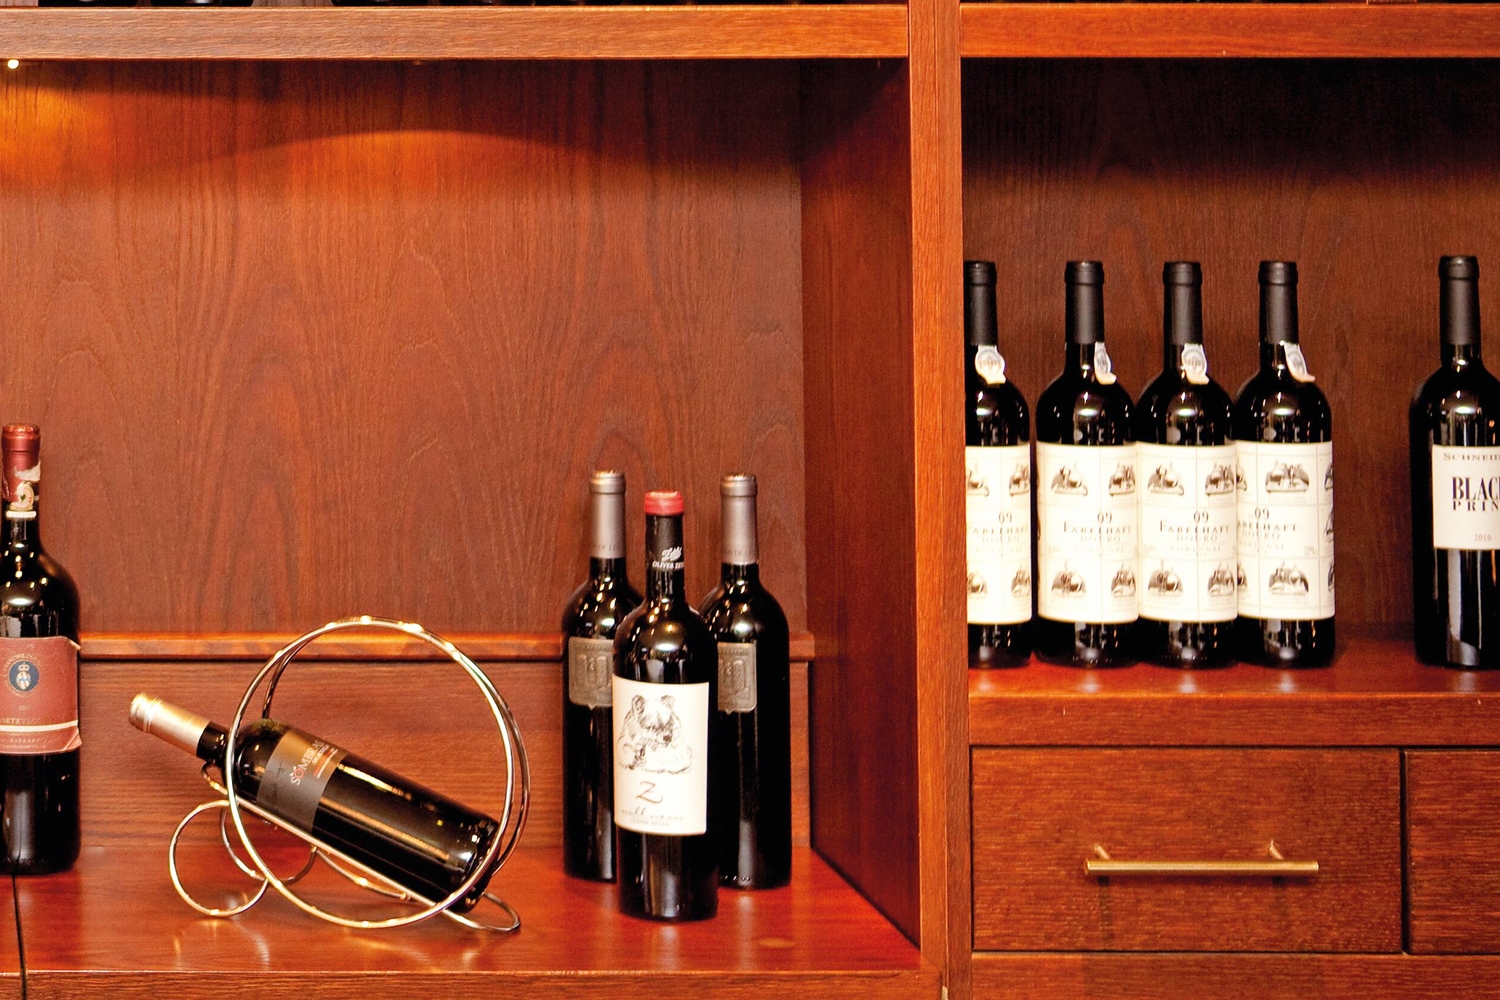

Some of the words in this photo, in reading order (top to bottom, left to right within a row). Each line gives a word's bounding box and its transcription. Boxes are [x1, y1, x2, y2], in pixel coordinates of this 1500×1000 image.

[1443, 452, 1500, 461] SCHNEID
[1452, 476, 1500, 500] BLAC
[1452, 500, 1500, 512] PRIN
[998, 511, 1012, 523] 09
[1097, 511, 1112, 523] 09
[1193, 510, 1209, 523] 09
[1254, 507, 1270, 519] 09
[969, 524, 1028, 535] ABELHAFT
[1064, 520, 1132, 534] FABELHAFT
[1160, 520, 1230, 533] FABELHAFT
[1237, 521, 1298, 531] ABELHAFT
[1474, 533, 1492, 542] 2010
[289, 740, 325, 786] SOMBRAS
[636, 780, 663, 804] Z
